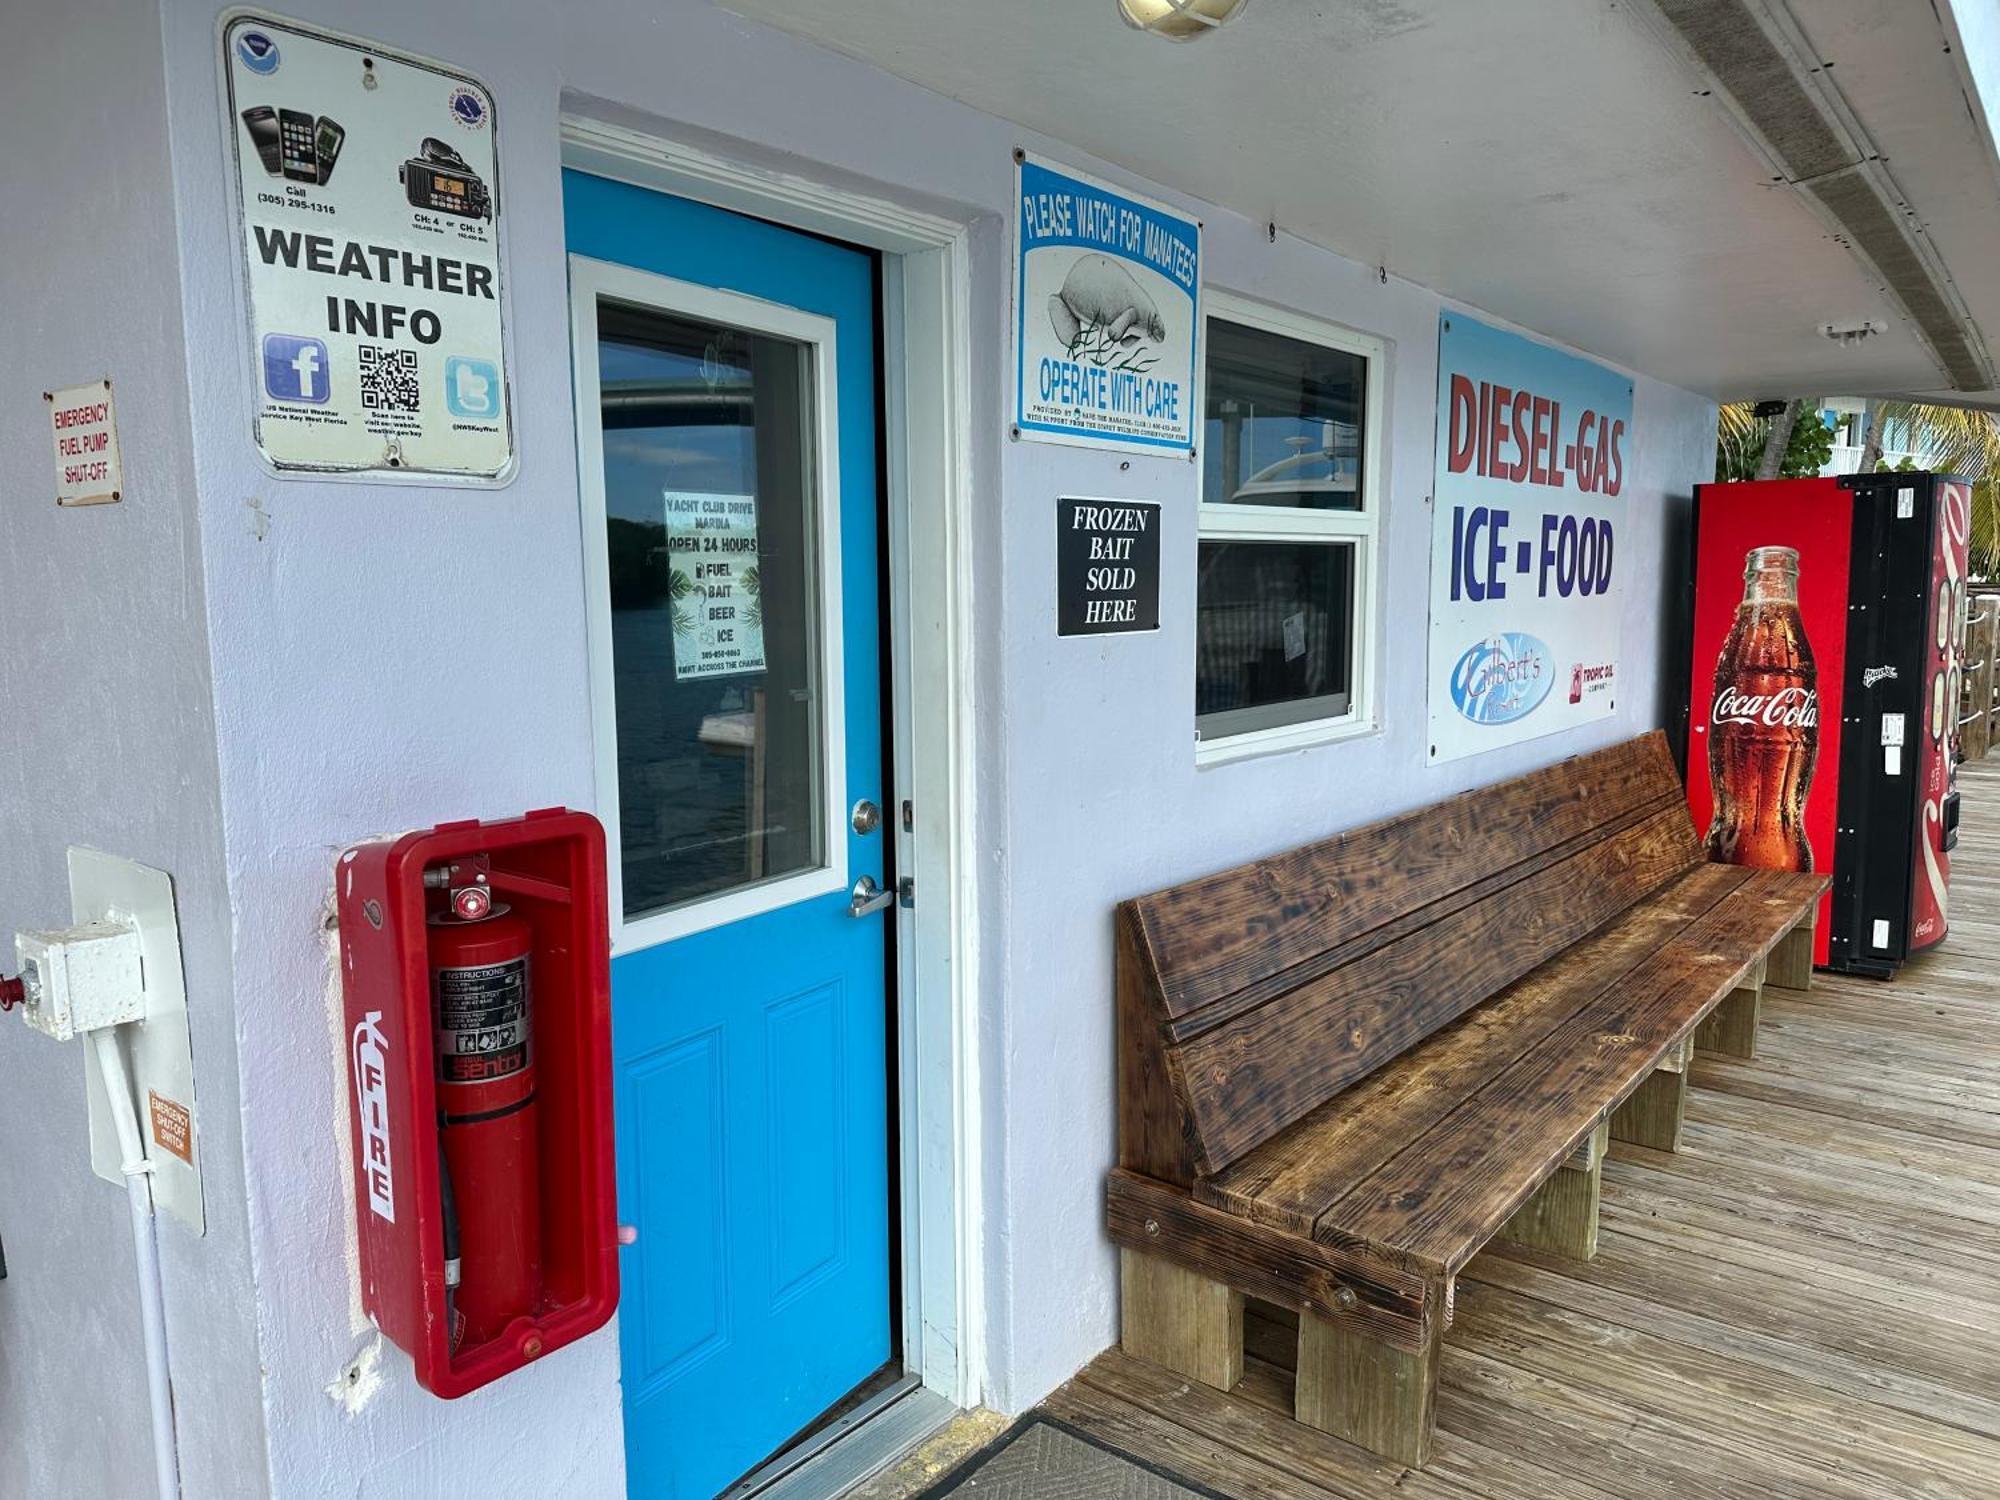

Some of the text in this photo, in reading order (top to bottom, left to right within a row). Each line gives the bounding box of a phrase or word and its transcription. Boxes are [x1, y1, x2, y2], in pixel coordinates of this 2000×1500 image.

[286, 185, 306, 198] Call
[258, 192, 336, 214] (305) 295-1316
[414, 213, 431, 224] CH:
[433, 217, 440, 226] 4
[460, 223, 476, 233] CH:
[478, 226, 484, 234] 5
[1023, 193, 1196, 288] PLEASE WATCH FOR MANATEES
[253, 225, 495, 300] WEATHER
[326, 295, 442, 345] INFO
[1040, 357, 1178, 420] OPERATE WITH CARE
[54, 402, 109, 430] EMERGENCY
[260, 412, 348, 425] Service Key West Florida
[266, 404, 339, 417] US National Weather
[1027, 413, 1042, 421] WITH
[1043, 415, 1068, 424] SUPPORT
[1069, 418, 1085, 427] FROM
[1032, 405, 1062, 415] PROVIDED
[1065, 409, 1072, 417] BY
[1082, 412, 1096, 420] SAVE
[60, 432, 109, 457] FUEL PUMP
[65, 462, 108, 484] SHUT-OFF
[666, 498, 754, 515] YACHT CLUB DRIVE
[695, 517, 730, 530] MARINA
[1072, 506, 1149, 532] FROZEN
[668, 537, 757, 552] OPEN 24 HOURS
[1088, 536, 1135, 560] BAIT
[706, 563, 732, 578] FUEL
[1086, 567, 1136, 591] SOLD
[708, 585, 732, 599] BAIT
[709, 607, 735, 621] BEER
[1085, 599, 1137, 624] HERE
[717, 629, 734, 643] ICE
[678, 663, 696, 675] RIGHT
[725, 660, 737, 670] THE
[738, 658, 764, 669] CHANNEL
[1466, 638, 1541, 698] Gilbert's
[1583, 664, 1614, 682] TROPIC OIL
[1712, 686, 1818, 728] Coca-Cola
[446, 967, 505, 979] INSTRUCTIONS
[151, 1096, 189, 1128] EMERGENCY
[157, 1112, 185, 1141] SHUT-OFF
[366, 1064, 389, 1201] FIRE
[161, 1128, 185, 1152] SWITCH
